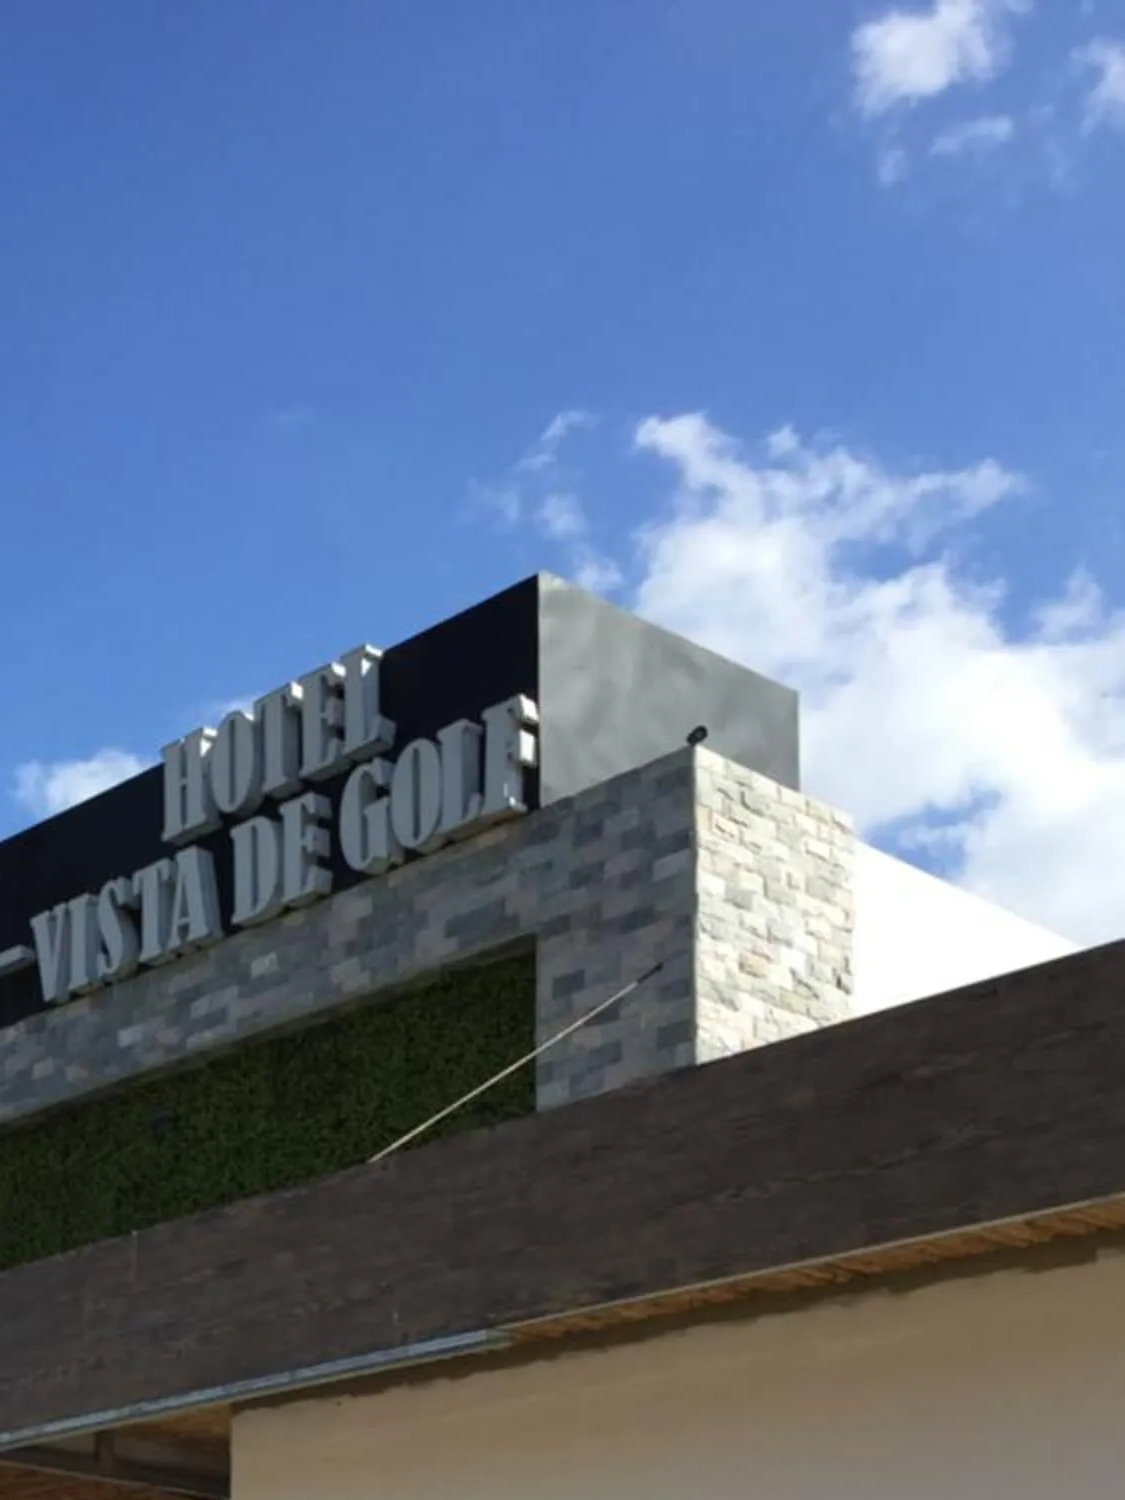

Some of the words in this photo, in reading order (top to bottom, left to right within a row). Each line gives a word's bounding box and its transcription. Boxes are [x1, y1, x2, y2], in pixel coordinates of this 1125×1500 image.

[31, 846, 224, 1002] VISTA
[231, 793, 332, 928] DE
[339, 695, 538, 875] GOLF
[161, 645, 395, 846] HOTEL
